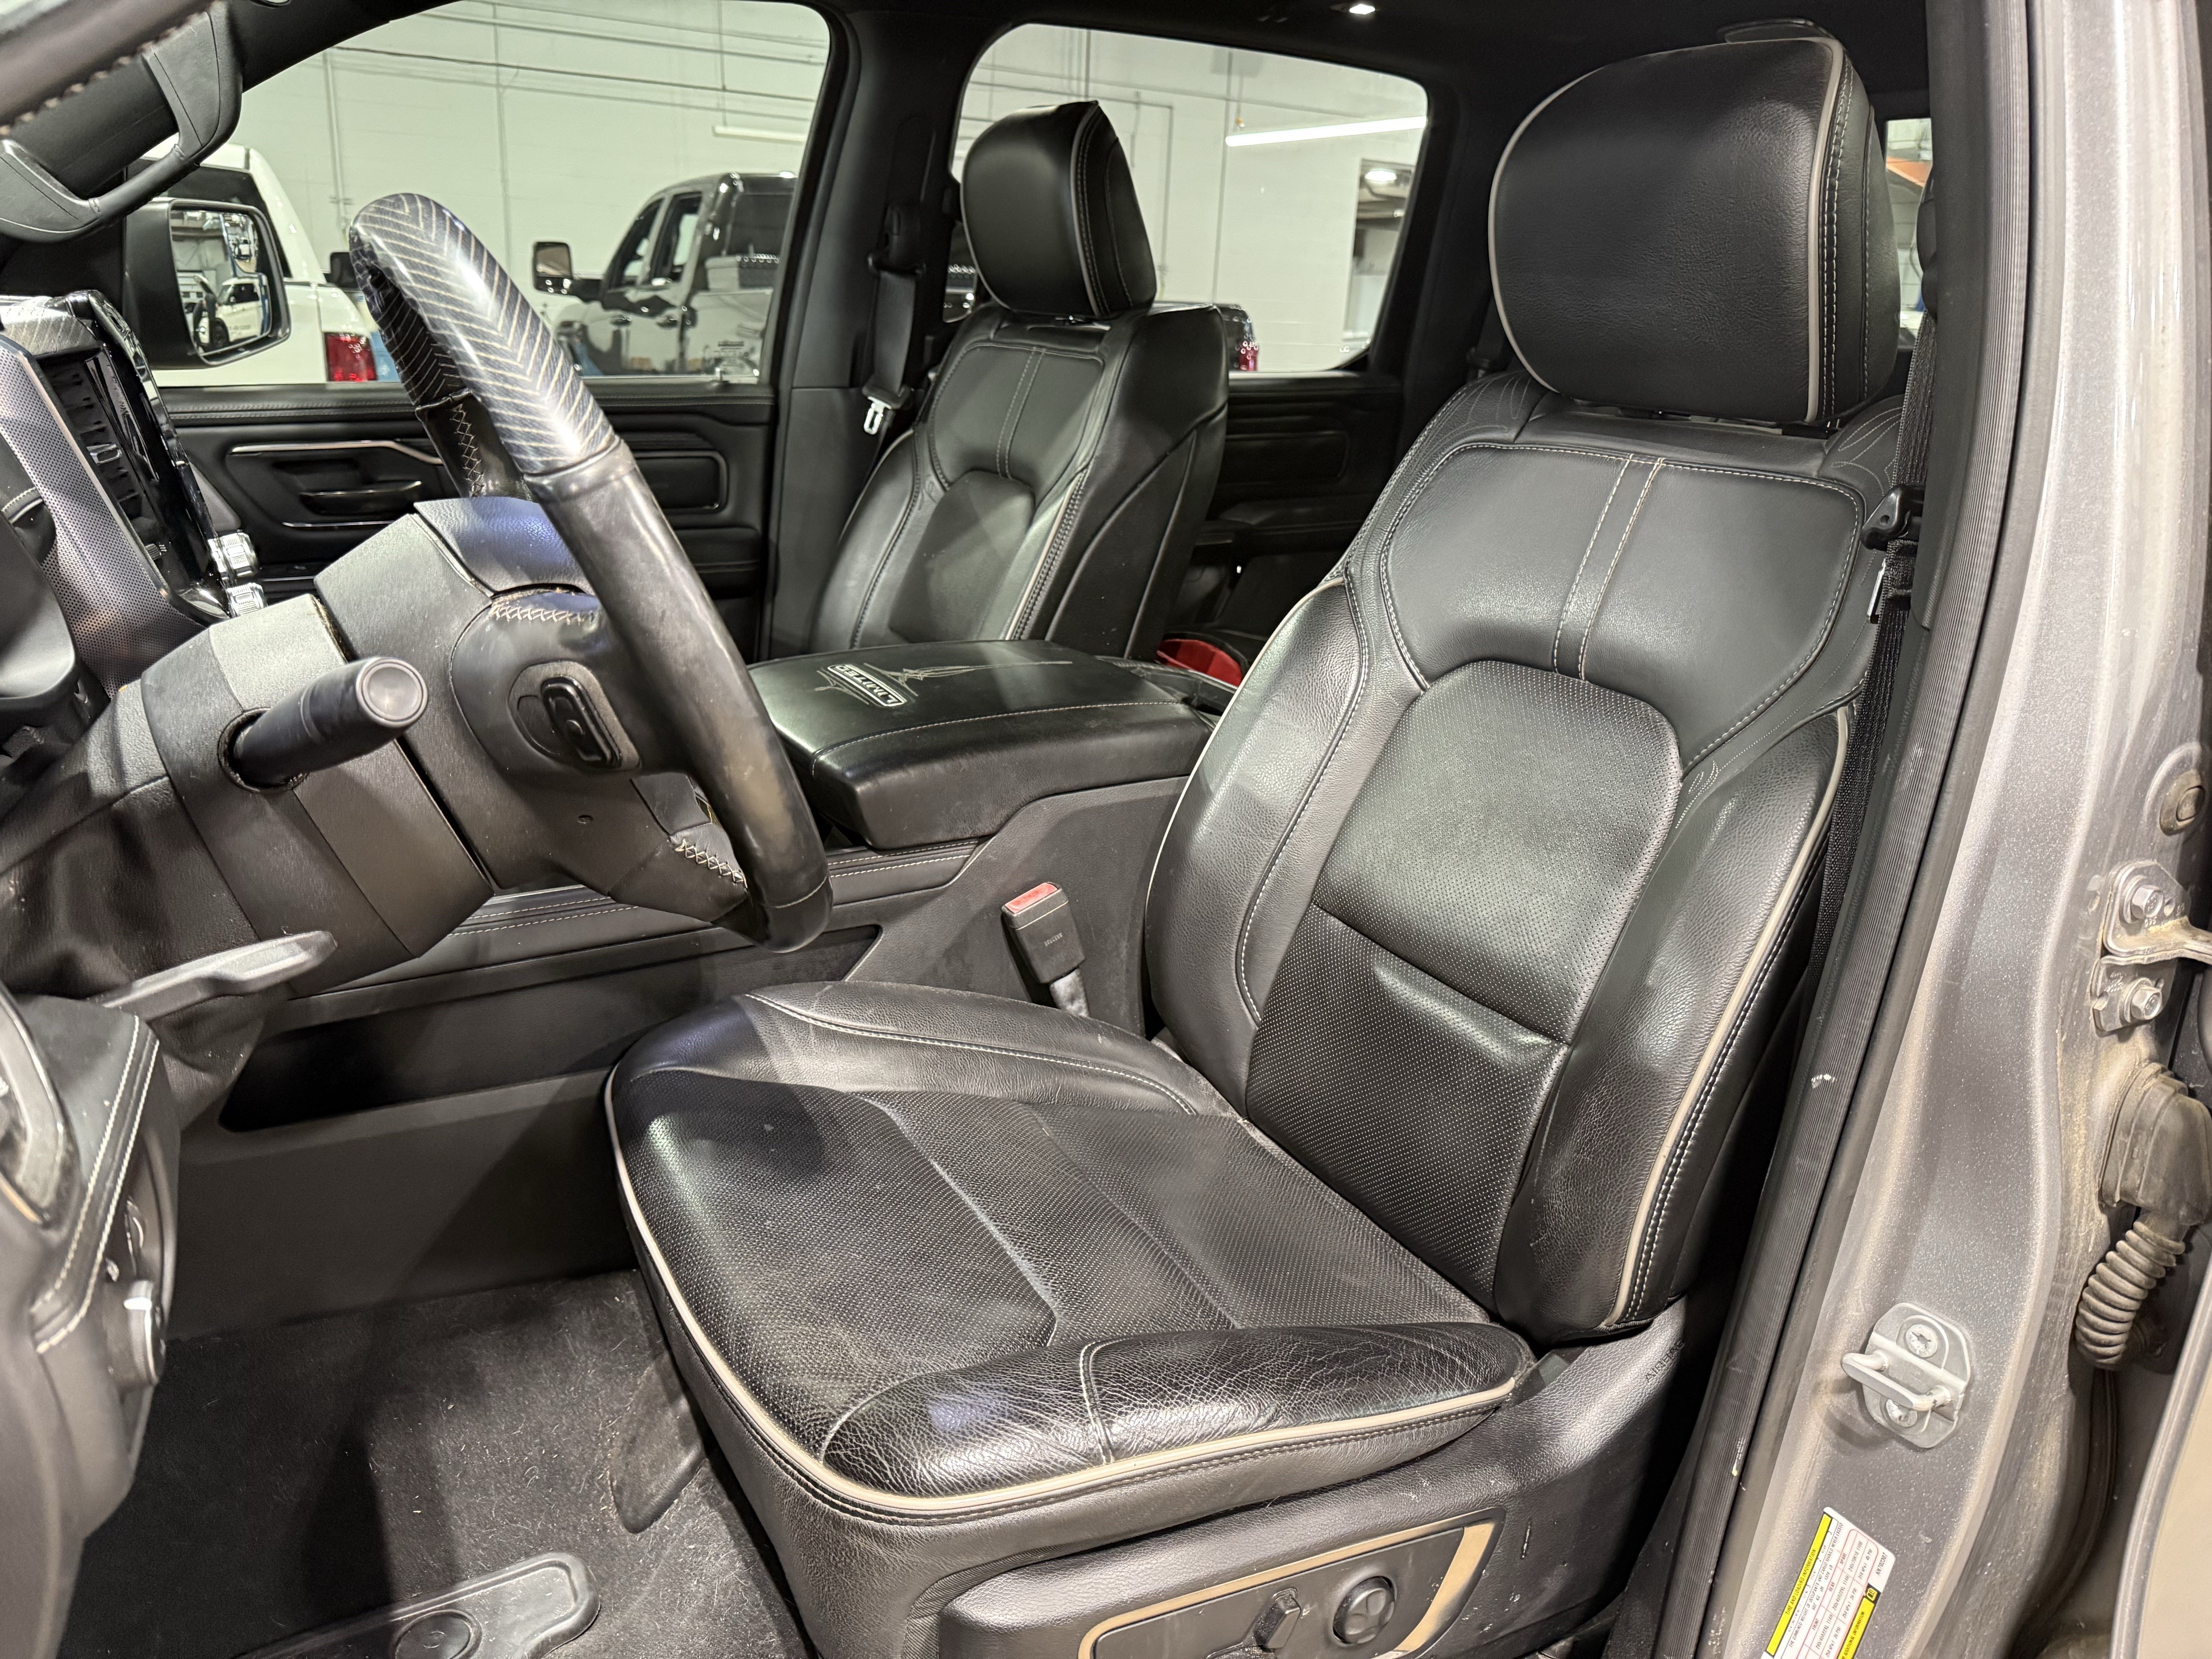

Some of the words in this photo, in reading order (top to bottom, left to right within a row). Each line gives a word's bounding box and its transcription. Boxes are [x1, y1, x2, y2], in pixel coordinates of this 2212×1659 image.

[835, 666, 899, 703] LIMITED
[1793, 1576, 1804, 1596] LOADING
[1801, 1548, 1816, 1577] INFORMATION
